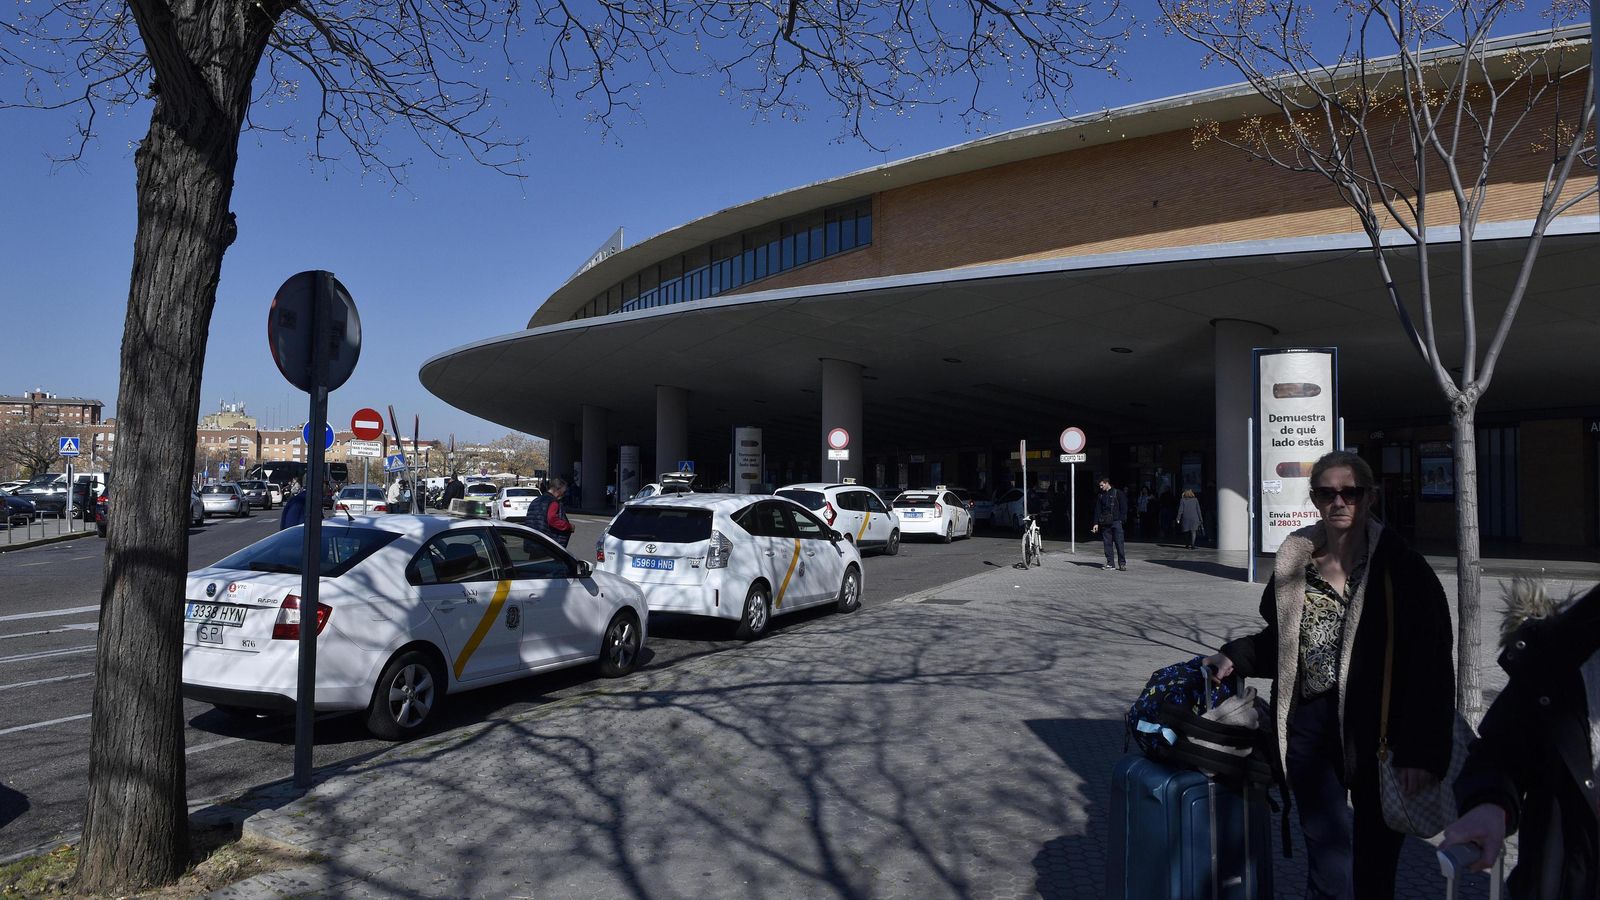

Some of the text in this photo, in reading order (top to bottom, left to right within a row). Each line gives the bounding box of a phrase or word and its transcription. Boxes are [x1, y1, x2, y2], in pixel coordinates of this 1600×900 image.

[1268, 413, 1326, 423] Demuestra
[1280, 425, 1317, 436] de qué
[1590, 421, 1600, 433] A
[1272, 437, 1324, 447] lado estás
[636, 558, 673, 570] 5969 HNB
[192, 605, 244, 622] 3338 HYN
[241, 639, 256, 648] 876
